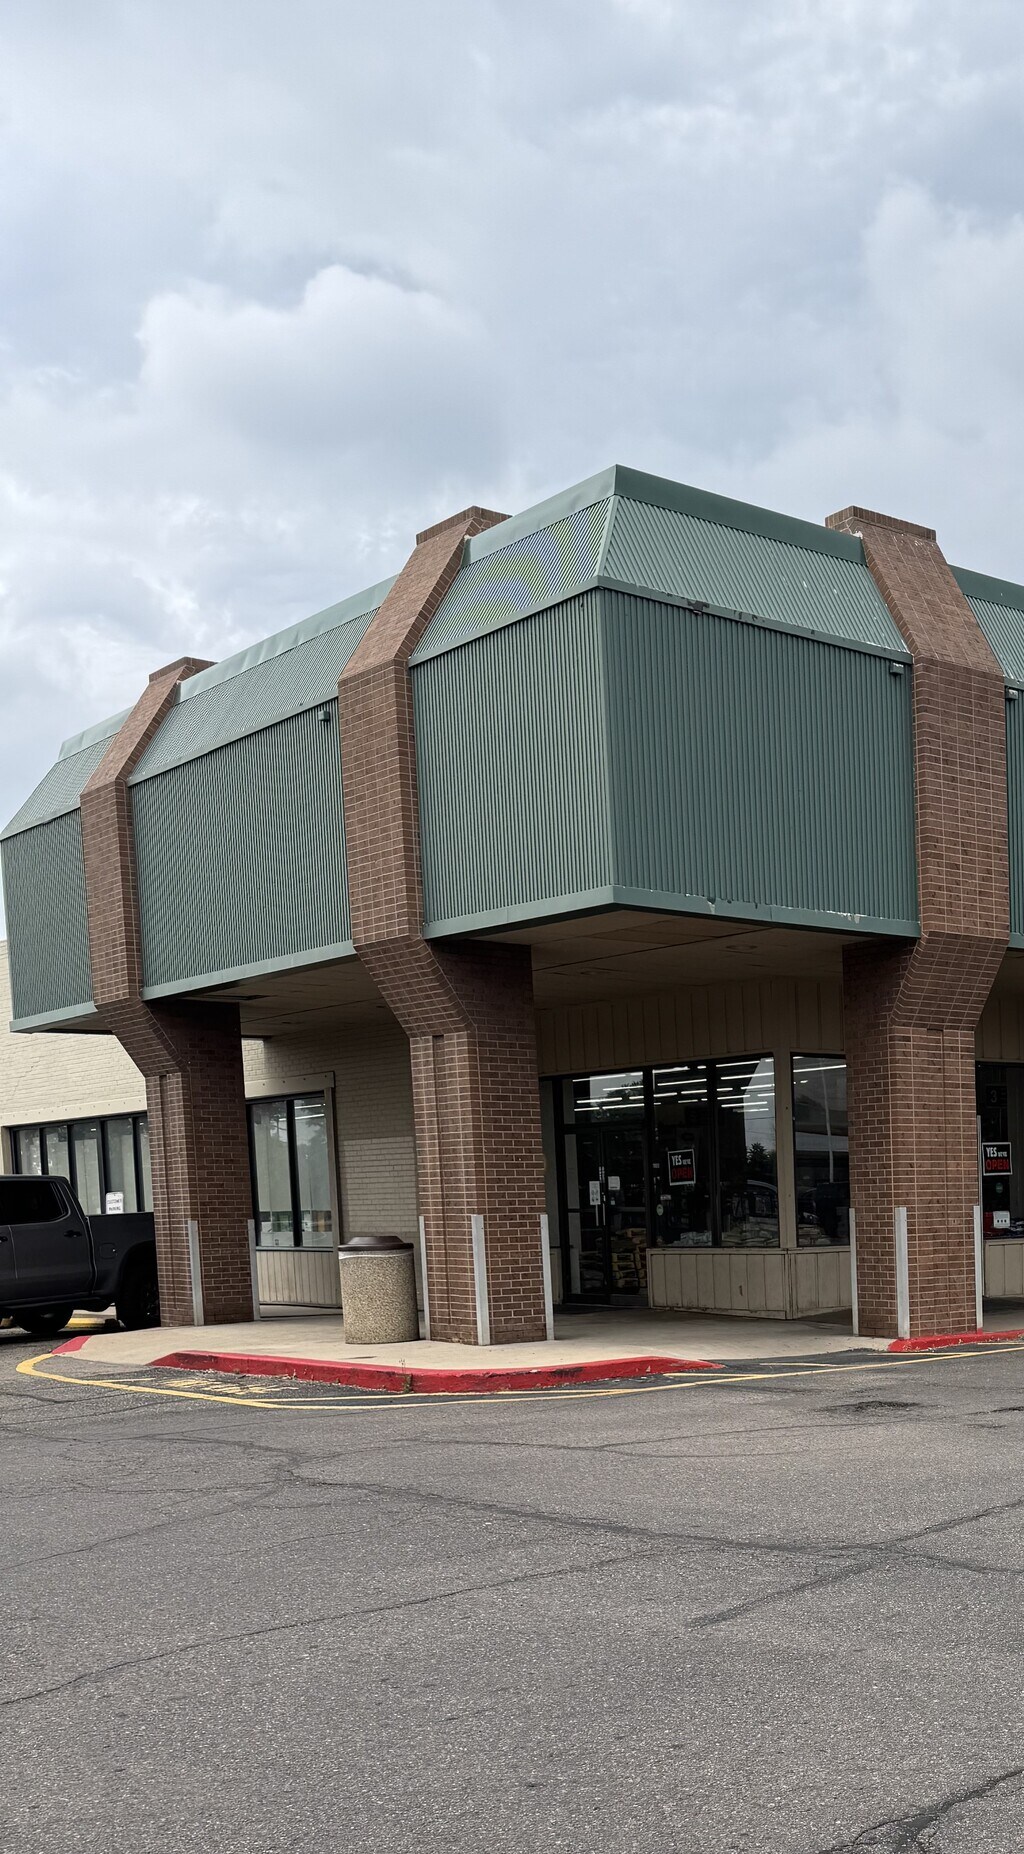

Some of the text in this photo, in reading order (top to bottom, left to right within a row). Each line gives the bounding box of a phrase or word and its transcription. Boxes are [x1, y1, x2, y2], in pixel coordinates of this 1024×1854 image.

[986, 1147, 997, 1157] YES
[672, 1155, 682, 1165] YES
[986, 1159, 1009, 1170] OPEN
[672, 1167, 693, 1180] OPEN
